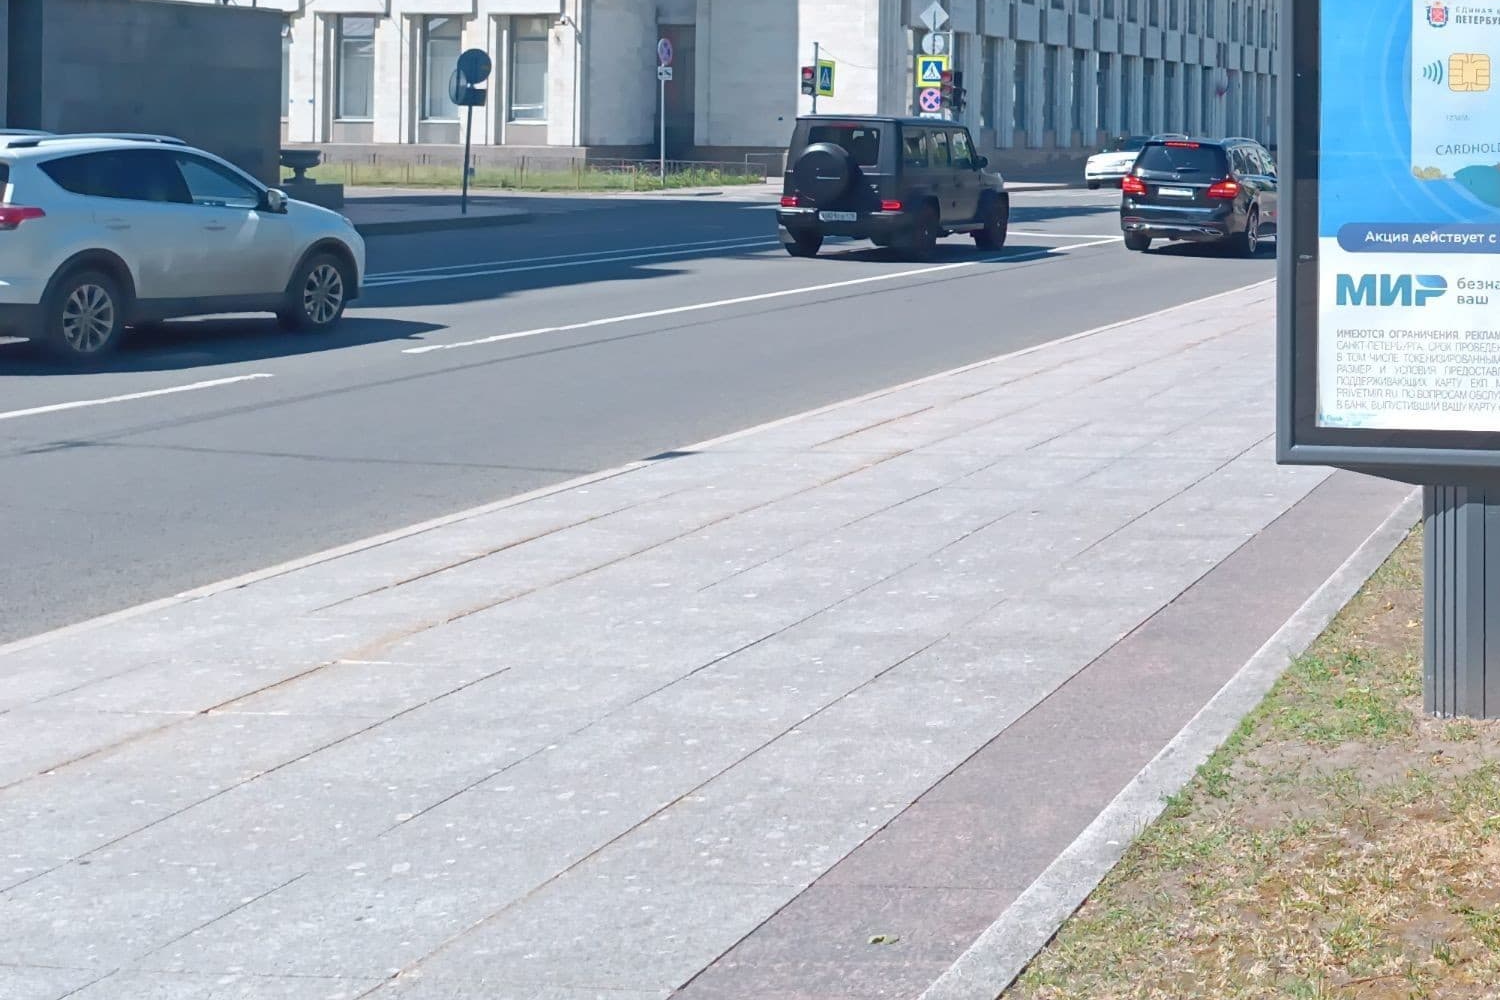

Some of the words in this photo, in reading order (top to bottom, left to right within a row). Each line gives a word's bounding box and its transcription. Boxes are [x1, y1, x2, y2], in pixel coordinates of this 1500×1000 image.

[1365, 231, 1409, 243] Акция
[1413, 231, 1485, 245] действует
[1489, 234, 1497, 243] с
[1336, 273, 1448, 306] МИР
[1457, 294, 1489, 305] ваш
[1336, 328, 1384, 339] ИМЕЮТСЯ
